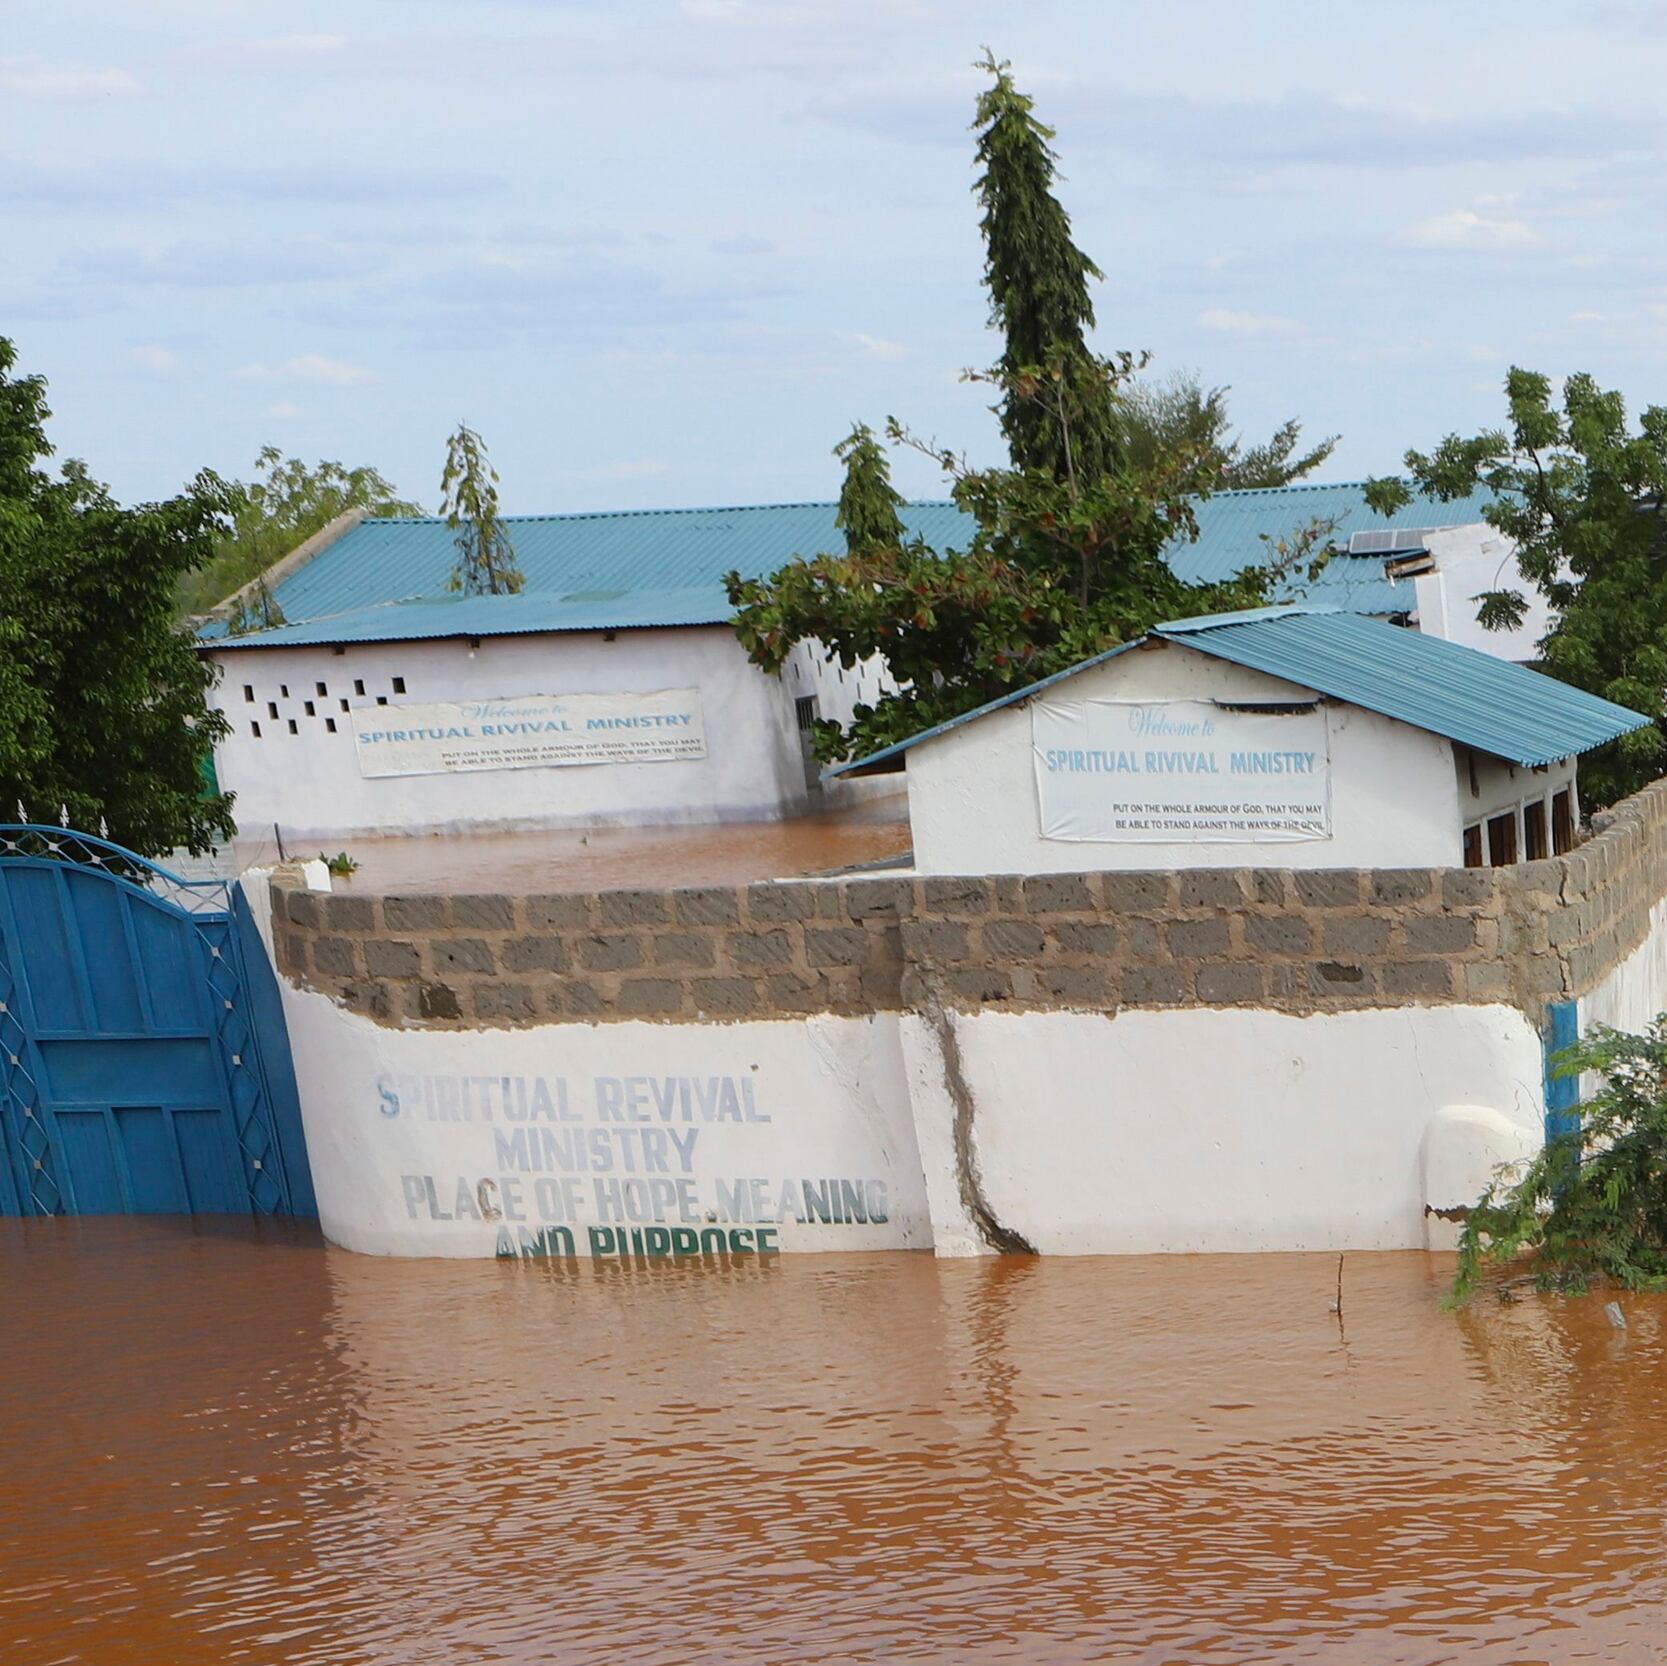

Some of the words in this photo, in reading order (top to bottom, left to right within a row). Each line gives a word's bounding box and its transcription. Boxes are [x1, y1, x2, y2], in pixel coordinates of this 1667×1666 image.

[461, 702, 546, 720] Welcome
[551, 703, 568, 716] to
[1128, 705, 1200, 737] Welcome
[1202, 719, 1216, 736] to
[358, 726, 475, 745] SPIRITUAL
[481, 720, 572, 737] RIVIVAL
[585, 712, 692, 730] MINISTRY
[480, 749, 501, 757] THE
[502, 747, 538, 756] WHOLE
[1046, 750, 1140, 773] SPIRITUAL
[1144, 751, 1219, 774] RIVIVAL
[1230, 751, 1315, 774] MINISTRY
[1113, 804, 1128, 813] PUT
[1130, 804, 1143, 813] ON
[1144, 804, 1160, 813] THE
[1162, 804, 1192, 813] WHOLE
[1193, 804, 1229, 814] ARMOUR
[1230, 804, 1241, 814] OF
[1265, 804, 1286, 814] THAT
[1288, 804, 1304, 814] YOU
[1305, 804, 1322, 814] MAY
[1115, 820, 1127, 829] BE
[1128, 820, 1149, 829] ABLE
[1151, 820, 1162, 829] TO
[1164, 820, 1191, 829] STAND
[1192, 820, 1227, 830] AGAINST
[1228, 820, 1246, 830] THE
[375, 1074, 583, 1123] SPIRITUAL
[593, 1075, 772, 1123] REVIVAL
[492, 1127, 700, 1173] MINISTRY
[400, 1174, 526, 1223] PLACE
[533, 1177, 584, 1223] OF
[495, 1225, 576, 1260] AND
